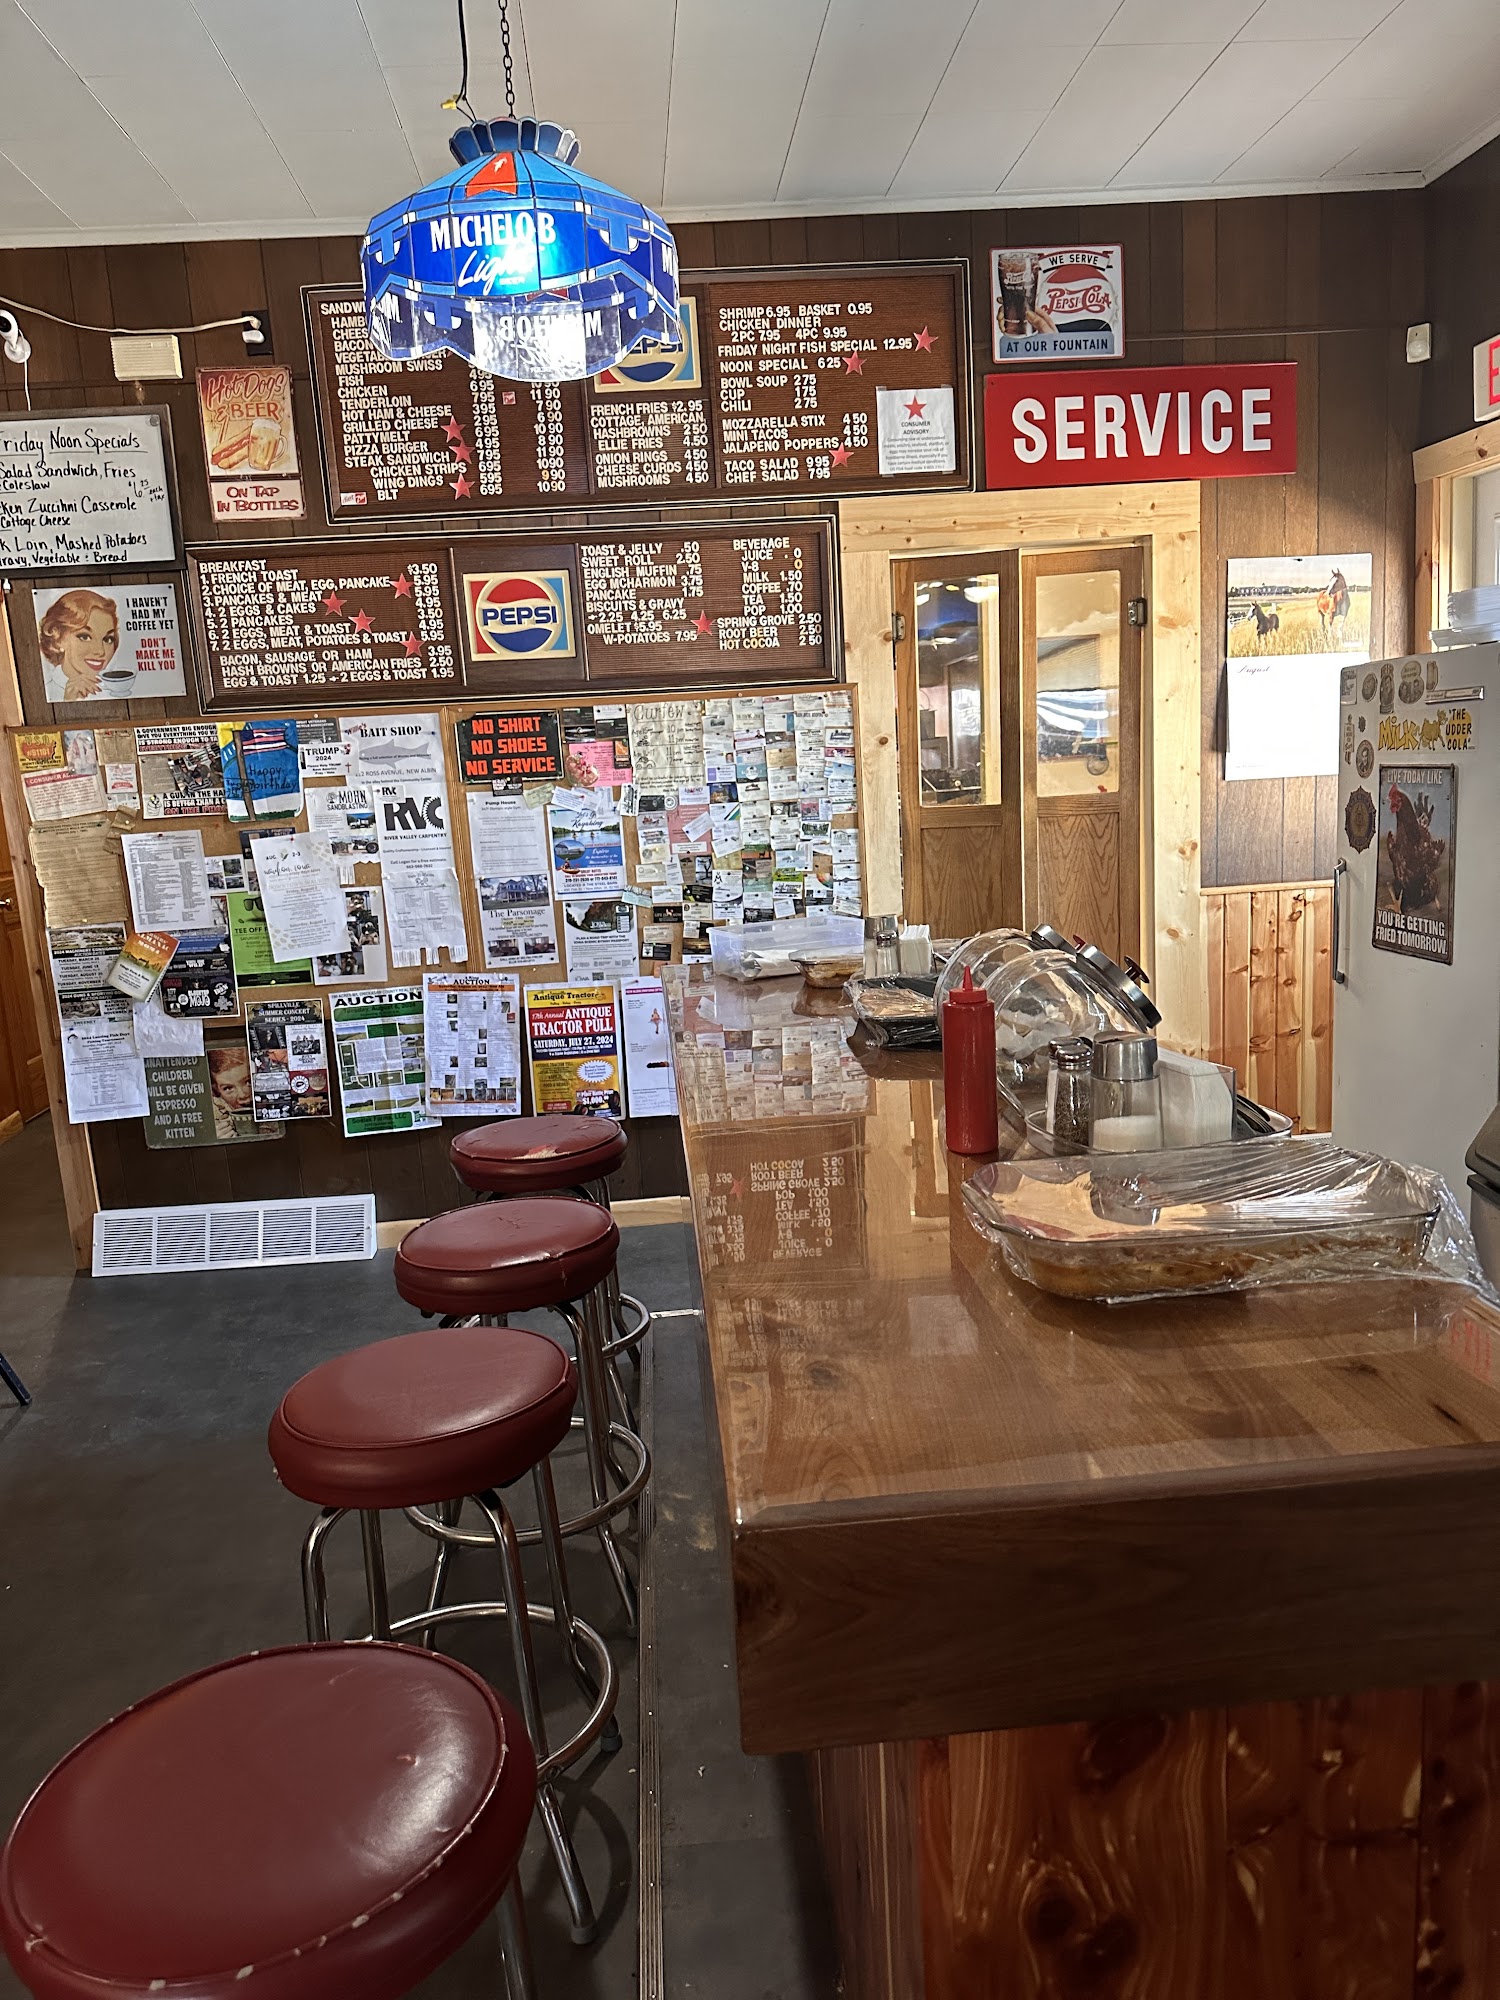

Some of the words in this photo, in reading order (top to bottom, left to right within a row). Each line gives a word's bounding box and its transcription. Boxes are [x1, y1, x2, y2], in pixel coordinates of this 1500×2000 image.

[429, 211, 556, 252] MICHELOB
[1049, 255, 1065, 265] WE
[1069, 254, 1099, 265] SERVE
[719, 306, 765, 320] SHRIMP
[798, 304, 841, 317] BASKET
[718, 344, 759, 357] FRIDAY
[762, 342, 798, 355] NIGHT
[799, 341, 827, 354] FISH
[830, 338, 877, 352] SPECIAL
[883, 338, 913, 350] 12.95
[1006, 342, 1020, 353] AT
[1024, 341, 1047, 351] OUR
[1053, 338, 1108, 350] FOUNTAIN
[336, 362, 403, 376] MUSHROOM
[406, 360, 443, 371] SWISS
[206, 375, 244, 409] Hot
[244, 372, 285, 401] Dogs
[339, 396, 412, 410] TENDERLOIN
[231, 403, 279, 420] BEER
[1011, 388, 1271, 464] SERVICE
[50, 427, 82, 449] Noon
[84, 428, 139, 454] Specials
[343, 431, 410, 444] PATTYMELT
[344, 445, 378, 456] PIZZA
[382, 442, 428, 454] BURGER
[0, 462, 32, 479] Salad
[105, 461, 136, 478] Fries
[370, 465, 421, 478] CHICKEN
[425, 462, 467, 474] STRIPS
[724, 460, 758, 472] TACO
[761, 457, 799, 470] SALAD
[372, 478, 405, 489] WING
[408, 475, 444, 487] DINGS
[597, 473, 671, 488] MUSHROOMS
[226, 487, 247, 498] ON
[250, 486, 280, 497] TAP
[377, 489, 398, 501] BLT
[81, 496, 136, 513] Casserole
[217, 501, 230, 512] IN
[234, 499, 299, 511] BOTTLES
[1, 517, 36, 533] Cottage
[40, 516, 70, 526] Cheese
[56, 534, 101, 550] Mashed
[103, 532, 147, 549] Potatoes
[733, 537, 790, 550] BEVERAGE
[32, 552, 80, 566] Vegetable
[93, 550, 127, 562] Bread
[582, 556, 621, 567] SWEET
[625, 554, 654, 565] ROLL
[676, 552, 700, 564] 2.50
[199, 559, 266, 573] BREAKFAST
[586, 588, 637, 602] PANCAKE
[682, 586, 703, 598] 1.75
[742, 582, 781, 594] COFFEE
[126, 598, 129, 608] I
[133, 597, 168, 608] HAVEN'T
[132, 610, 149, 619] HAD
[153, 609, 165, 618] MY
[482, 605, 558, 626] PEPSI
[126, 621, 155, 631] COFFEE
[159, 620, 173, 630] YET
[141, 638, 166, 648] DON'T
[136, 650, 159, 660] MAKE
[162, 649, 174, 658] ME
[219, 653, 262, 667] BACON,
[265, 651, 316, 664] SAUSAGE
[322, 650, 339, 661] OR
[346, 649, 372, 660] HAM
[428, 646, 452, 656] 3.95
[138, 661, 156, 672] KILL
[158, 660, 175, 670] YOU
[222, 666, 254, 677] HASH
[257, 663, 307, 675] BROWNS
[311, 662, 327, 673] OR
[332, 659, 389, 672] AMERICAN
[391, 658, 421, 669] FRIES
[429, 657, 453, 668] 2.50
[634, 703, 685, 720] Curfew
[360, 728, 388, 737] BAIT
[390, 726, 421, 736] SHOP
[472, 719, 494, 734] NO
[498, 717, 541, 734] SHIRT
[1446, 723, 1472, 735] UDDER
[305, 747, 340, 756] TRUMP
[471, 739, 493, 755] NO
[498, 737, 547, 753] SHOES
[249, 765, 281, 781] Happy
[465, 760, 488, 776] NO
[492, 757, 556, 774] SERVICE
[1387, 770, 1401, 783] LIVE
[1403, 770, 1424, 783] TODAY
[1427, 770, 1442, 784] LIKE
[384, 796, 444, 831] RVC
[488, 910, 505, 918] The
[506, 909, 545, 917] Parsonage
[1378, 910, 1405, 929] YOU'RE
[1407, 916, 1445, 937] GETTING
[1376, 926, 1396, 943] FRIED
[1397, 931, 1447, 954] TOMORROW.
[334, 991, 422, 1007] AUCTION
[533, 993, 564, 1001] Antique
[565, 1007, 612, 1019] ANTIQUE
[532, 1021, 583, 1036] TRACTOR
[585, 1018, 613, 1032] PULL
[534, 1038, 567, 1049] SATURDAY,
[569, 1038, 583, 1047] JULY
[597, 1035, 614, 1044] 2024
[152, 1069, 193, 1082] CHILDREN
[166, 1085, 177, 1096] BE
[179, 1083, 204, 1094] GIVEN
[156, 1098, 196, 1111] ESPRESSO
[155, 1115, 171, 1125] AND
[174, 1114, 180, 1124] A
[182, 1112, 203, 1123] FREE
[165, 1127, 195, 1139] KITTEN
